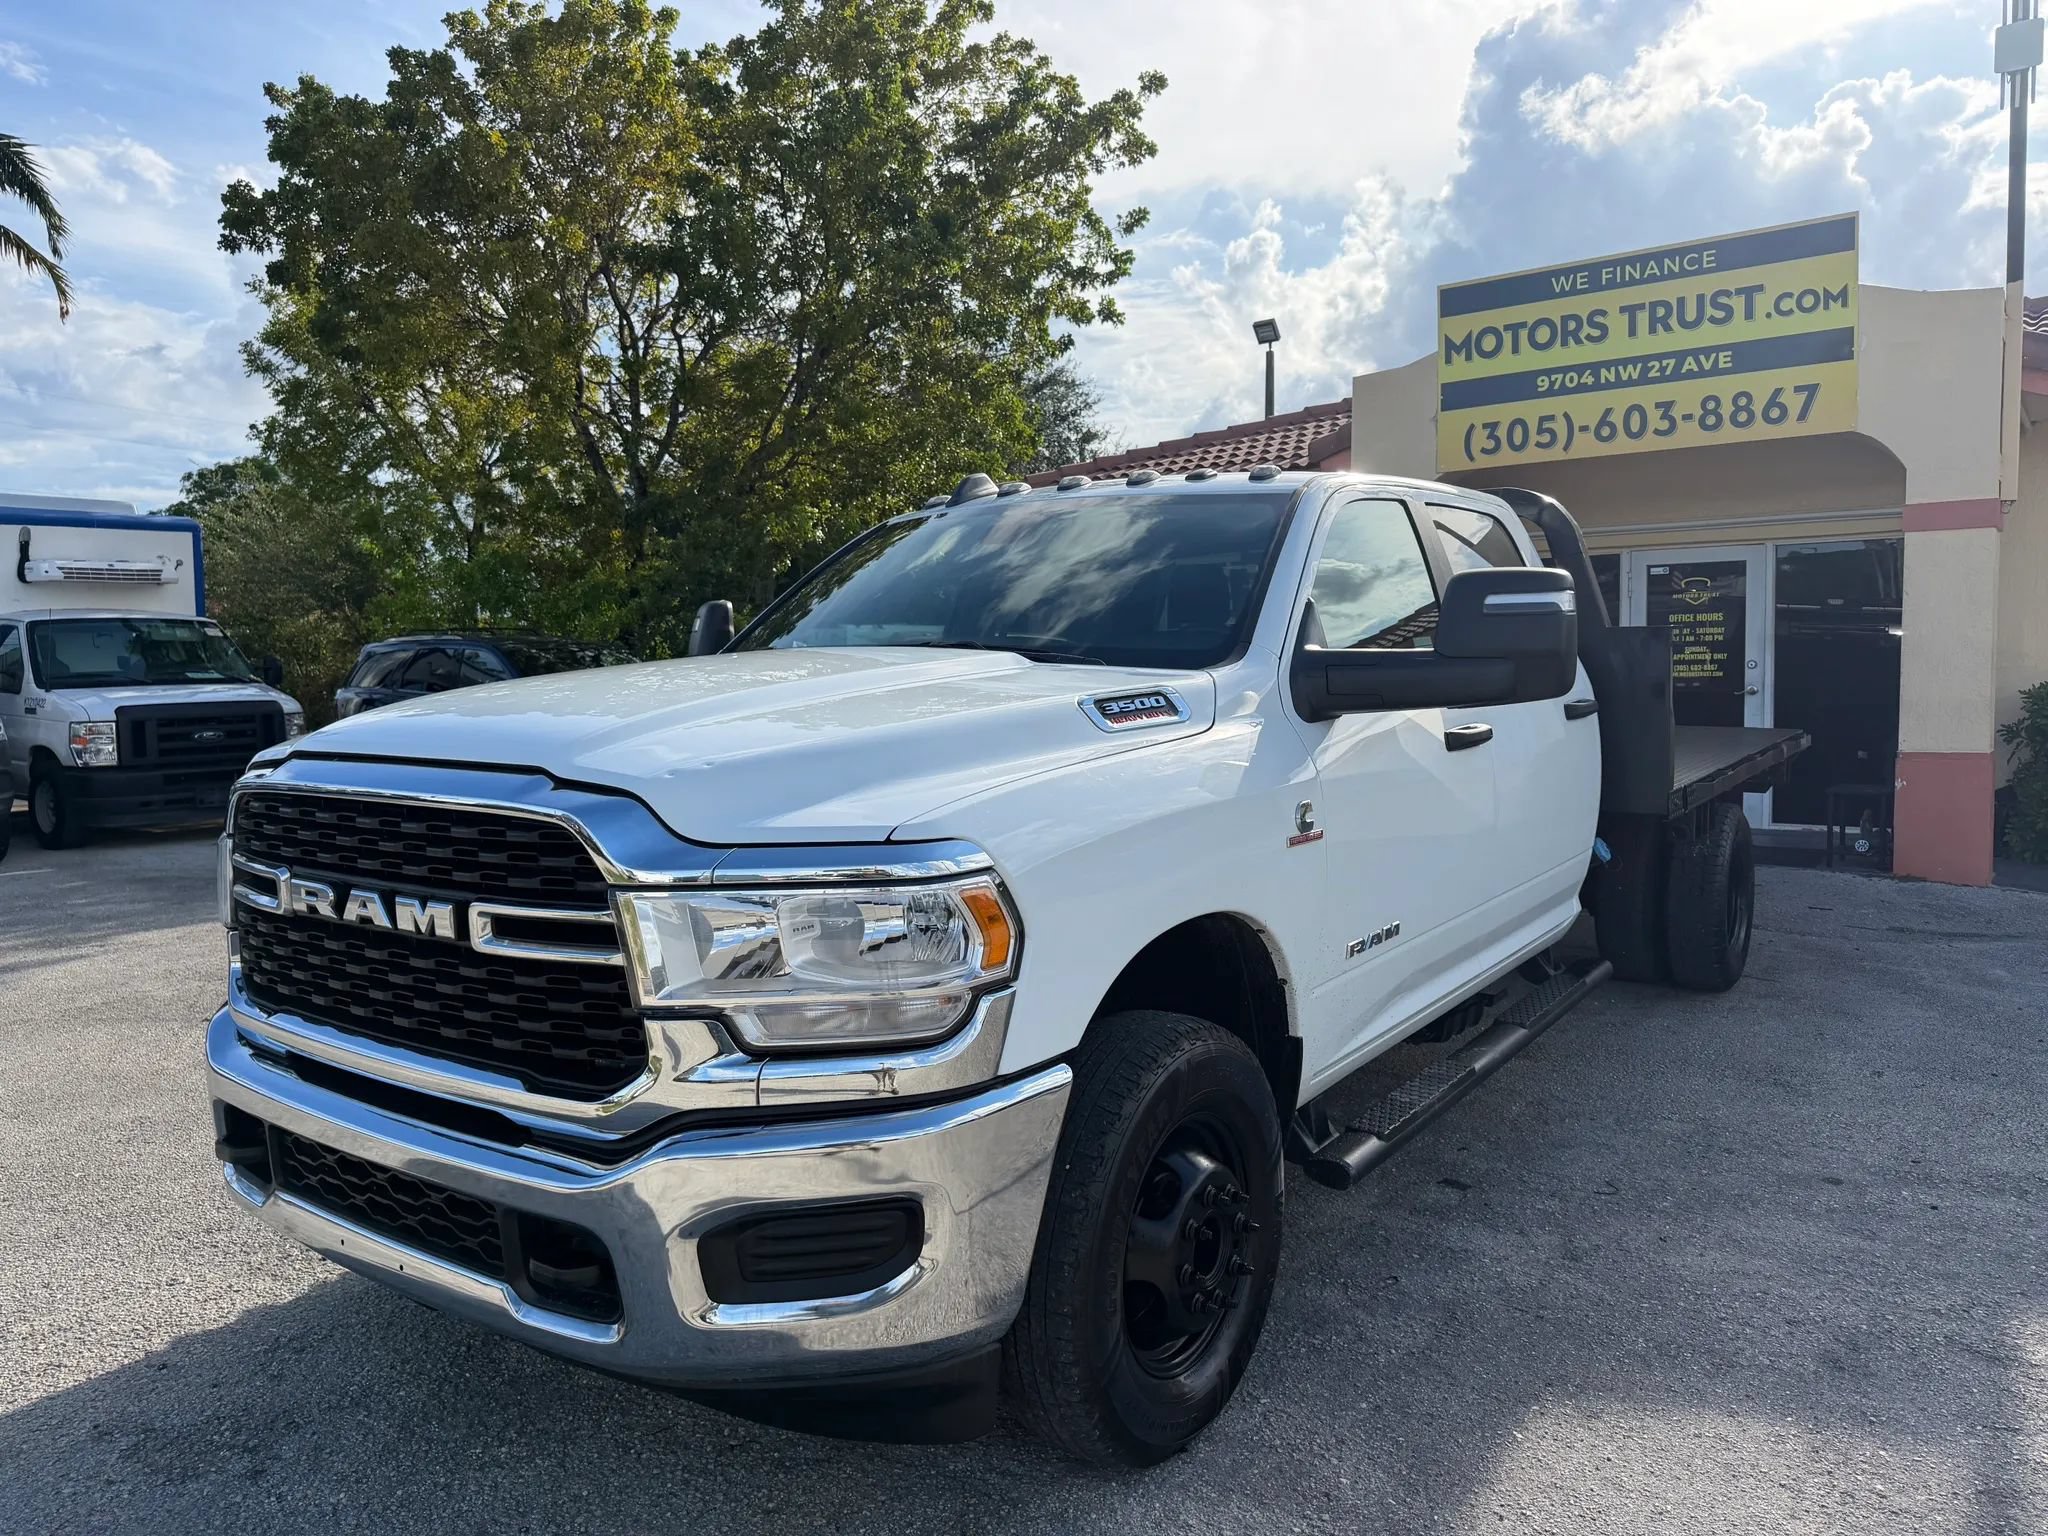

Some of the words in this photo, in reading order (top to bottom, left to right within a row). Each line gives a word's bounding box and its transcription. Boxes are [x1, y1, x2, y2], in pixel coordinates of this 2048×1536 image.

[1551, 271, 1590, 293] WE
[1601, 250, 1718, 285] FINANCE
[1443, 308, 1609, 366] MOTORS
[1536, 368, 1595, 392] 9704
[1600, 362, 1643, 384] NW
[1648, 359, 1677, 379] 27
[1681, 350, 1733, 374] AVE
[1463, 382, 1822, 462] (305)-603-8867
[1669, 613, 1695, 623] OFFICE
[1697, 612, 1724, 621] HOURS
[1101, 696, 1166, 714] 3500
[291, 878, 457, 940] RAM
[792, 924, 815, 933] RAM
[1345, 920, 1401, 960] RAM
